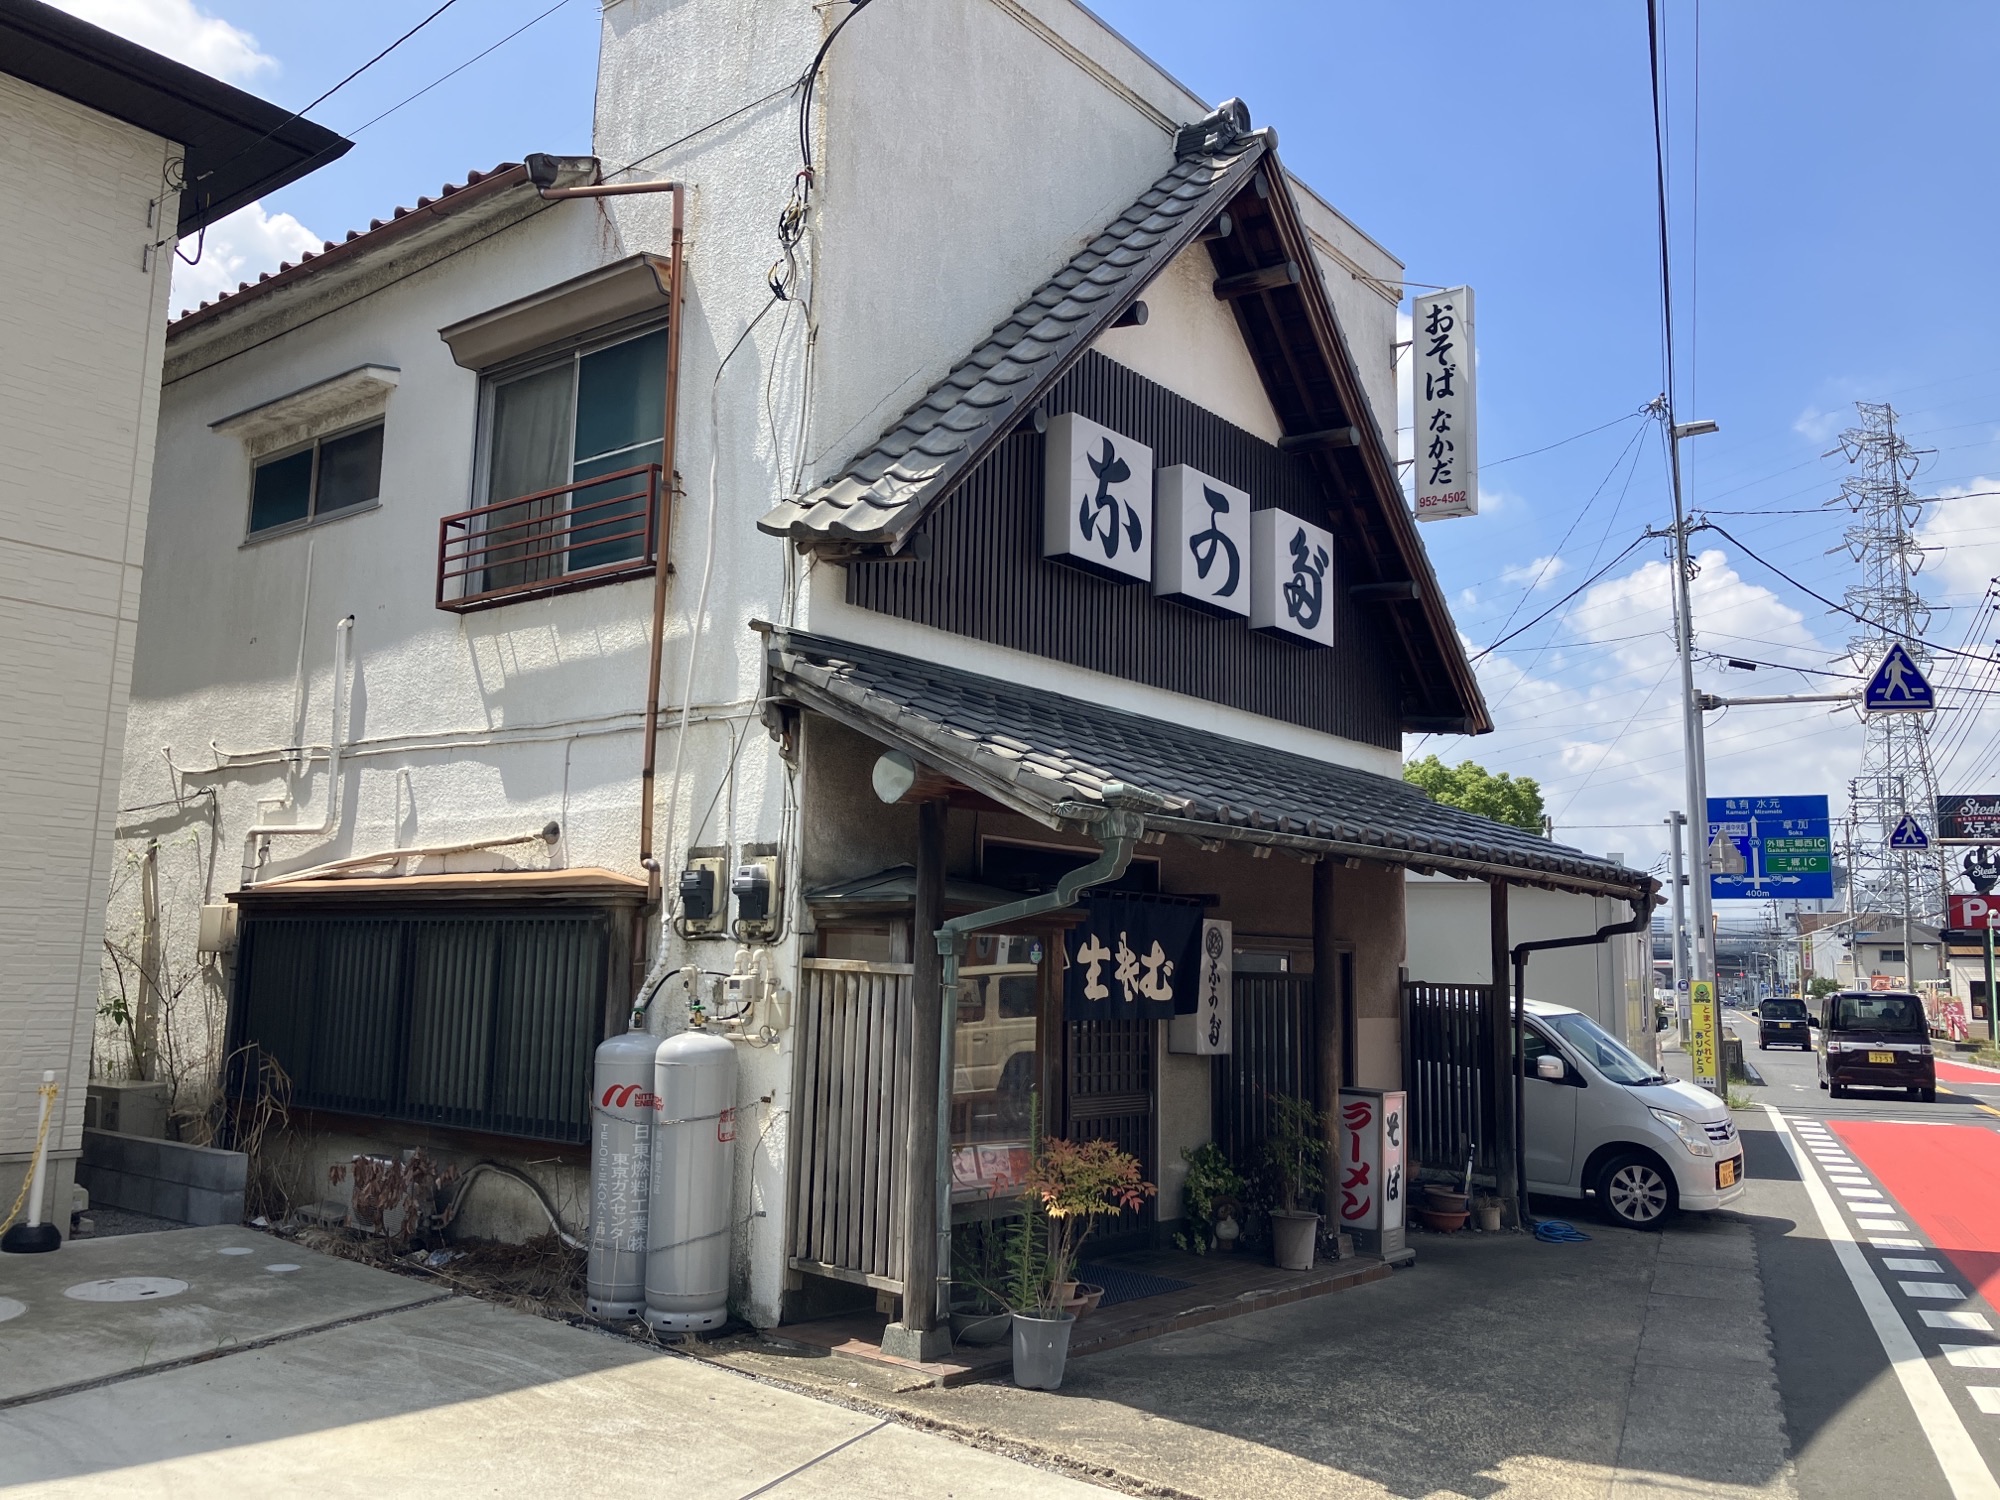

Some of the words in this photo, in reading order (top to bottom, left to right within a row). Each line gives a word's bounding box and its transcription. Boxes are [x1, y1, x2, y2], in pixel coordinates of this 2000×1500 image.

[1425, 304, 1456, 401] おそば
[1429, 408, 1454, 485] なかだ
[1419, 491, 1466, 508] 952-4502
[1757, 798, 1780, 808] 水元
[1783, 819, 1808, 829] 草加
[1972, 864, 1997, 877] Steak
[1962, 898, 1988, 927] P
[1695, 1031, 1704, 1074] ありがとう
[1702, 1006, 1712, 1064] とまってくれて
[1341, 1102, 1372, 1220] ラーメン
[1386, 1112, 1400, 1202] そば
